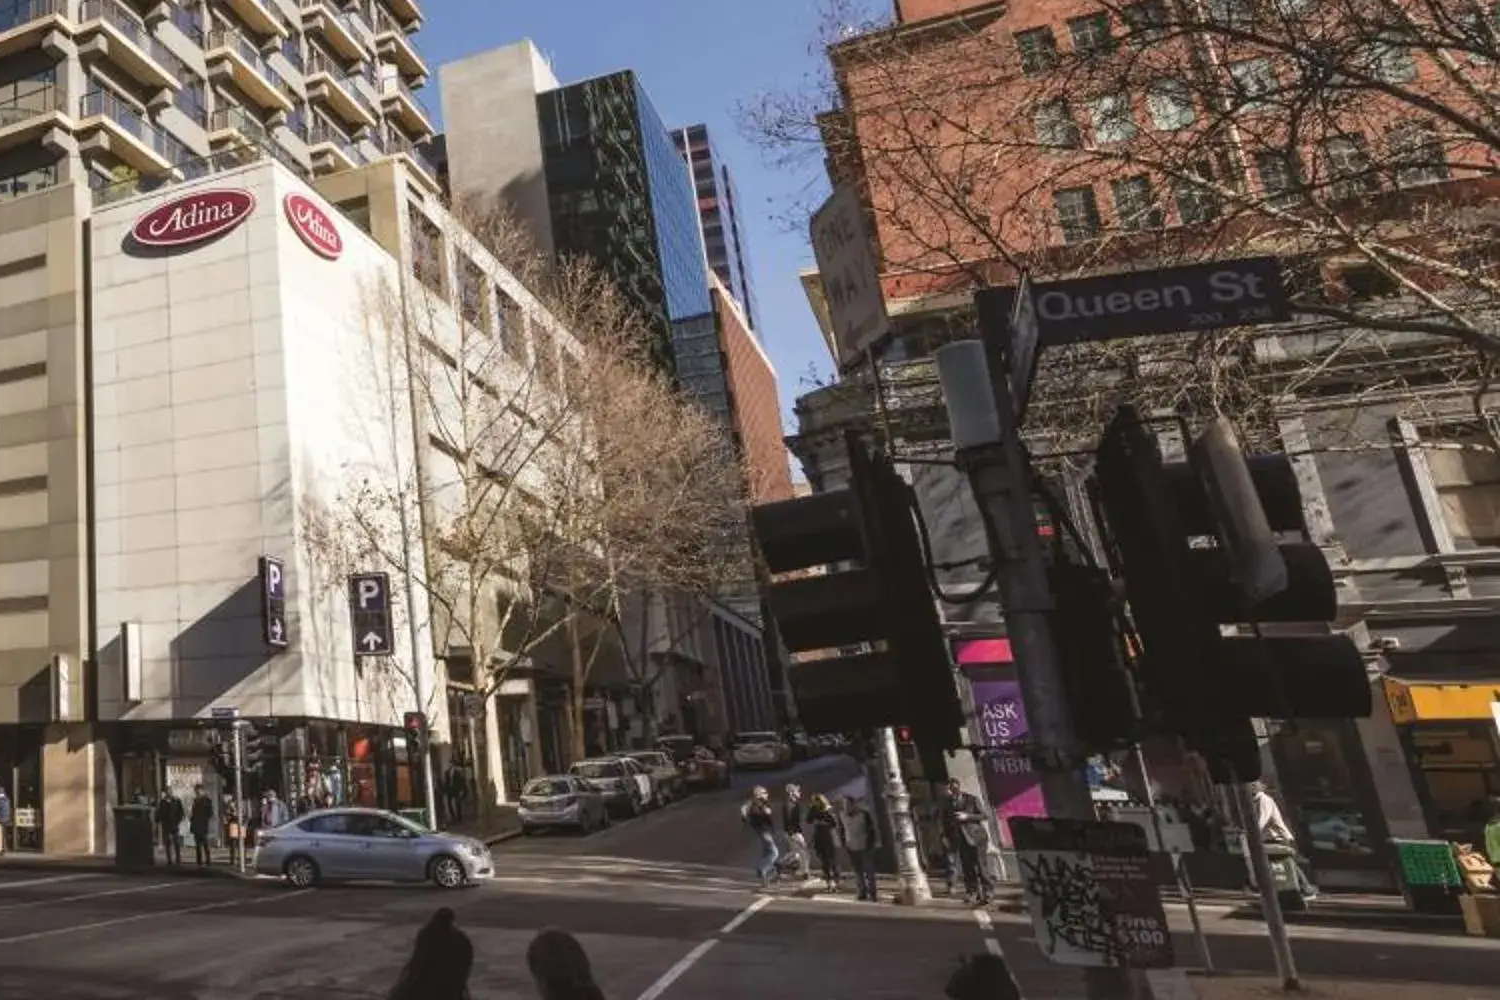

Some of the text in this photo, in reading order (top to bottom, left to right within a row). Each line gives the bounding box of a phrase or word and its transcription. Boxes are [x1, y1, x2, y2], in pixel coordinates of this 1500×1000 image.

[149, 200, 234, 237] Adina
[297, 204, 337, 249] Adina
[1036, 270, 1267, 321] Queen St
[269, 563, 281, 593] P
[359, 579, 379, 609] P
[982, 702, 1018, 720] ASK
[985, 721, 1010, 737] US
